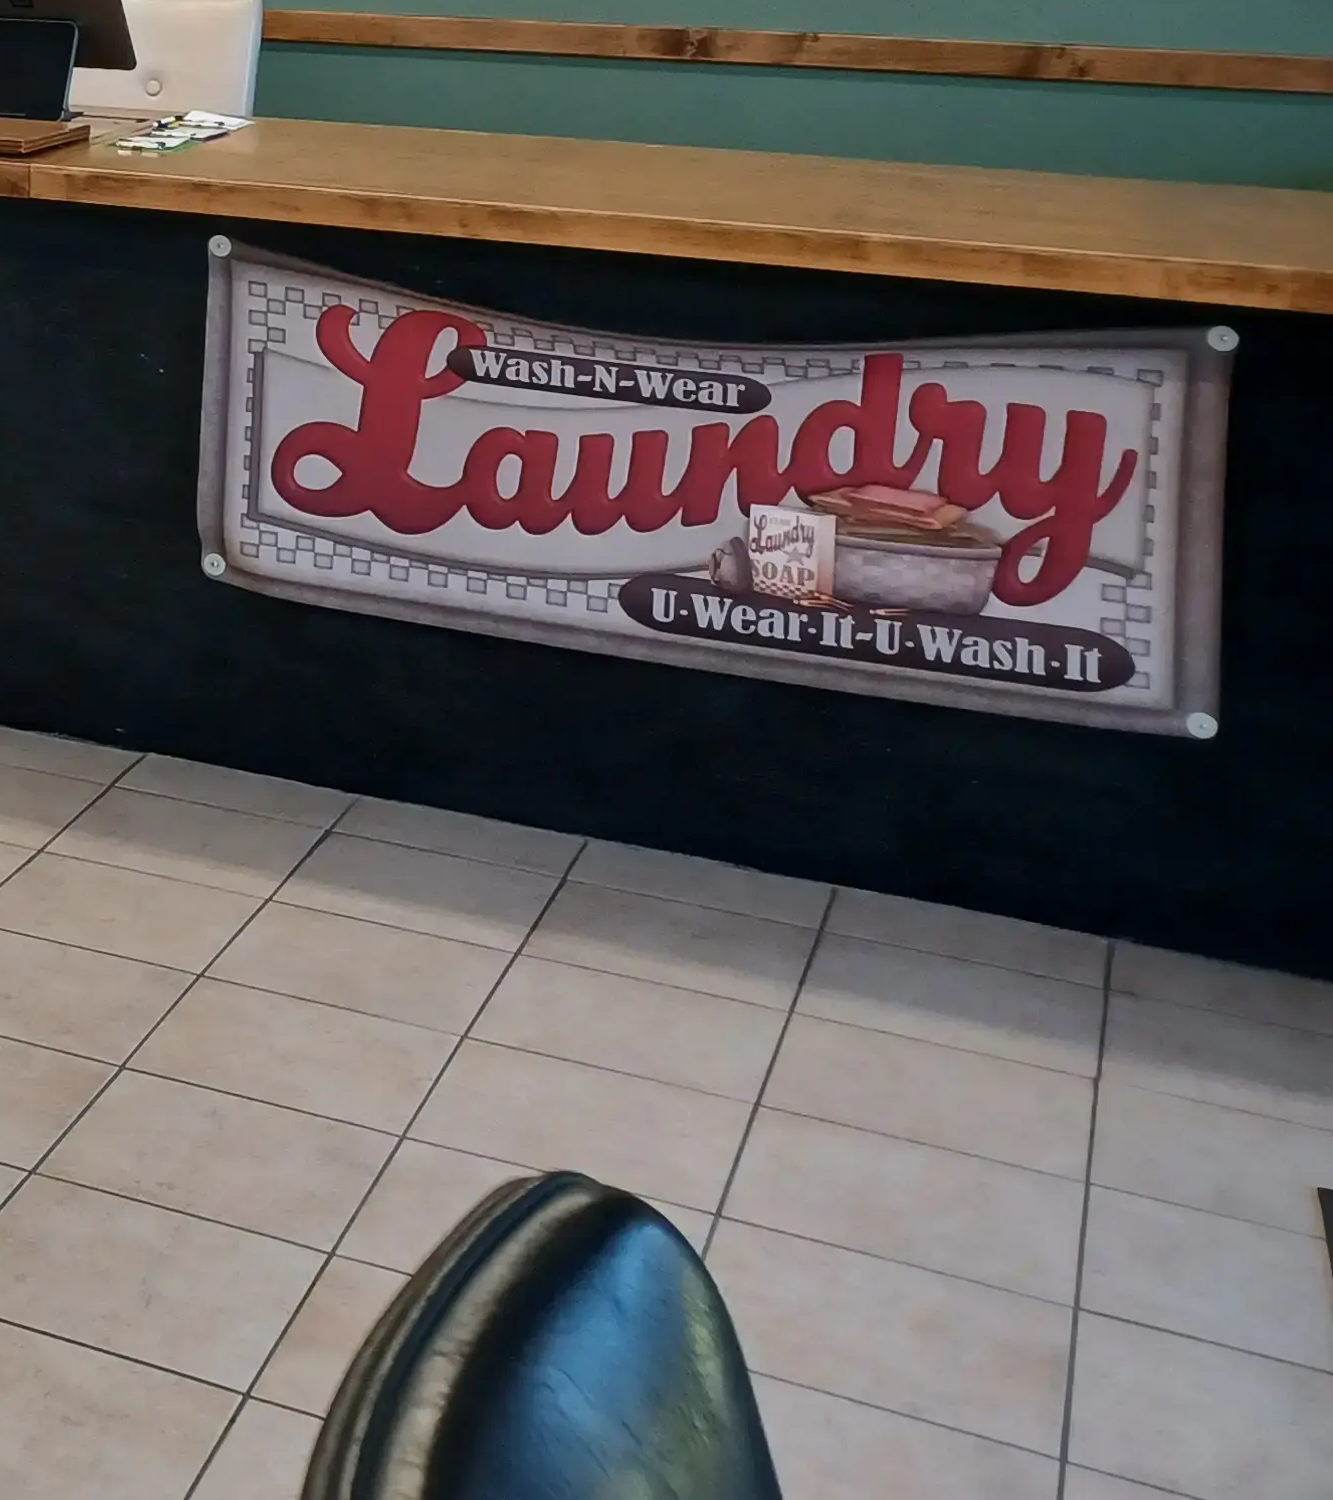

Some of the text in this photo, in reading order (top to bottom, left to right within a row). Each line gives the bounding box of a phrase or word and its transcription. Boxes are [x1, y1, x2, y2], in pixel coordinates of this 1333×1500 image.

[466, 346, 746, 410] Wash-N-Wear
[269, 302, 1139, 608] Laundry
[749, 514, 815, 559] Laundry
[751, 558, 816, 587] SOAP
